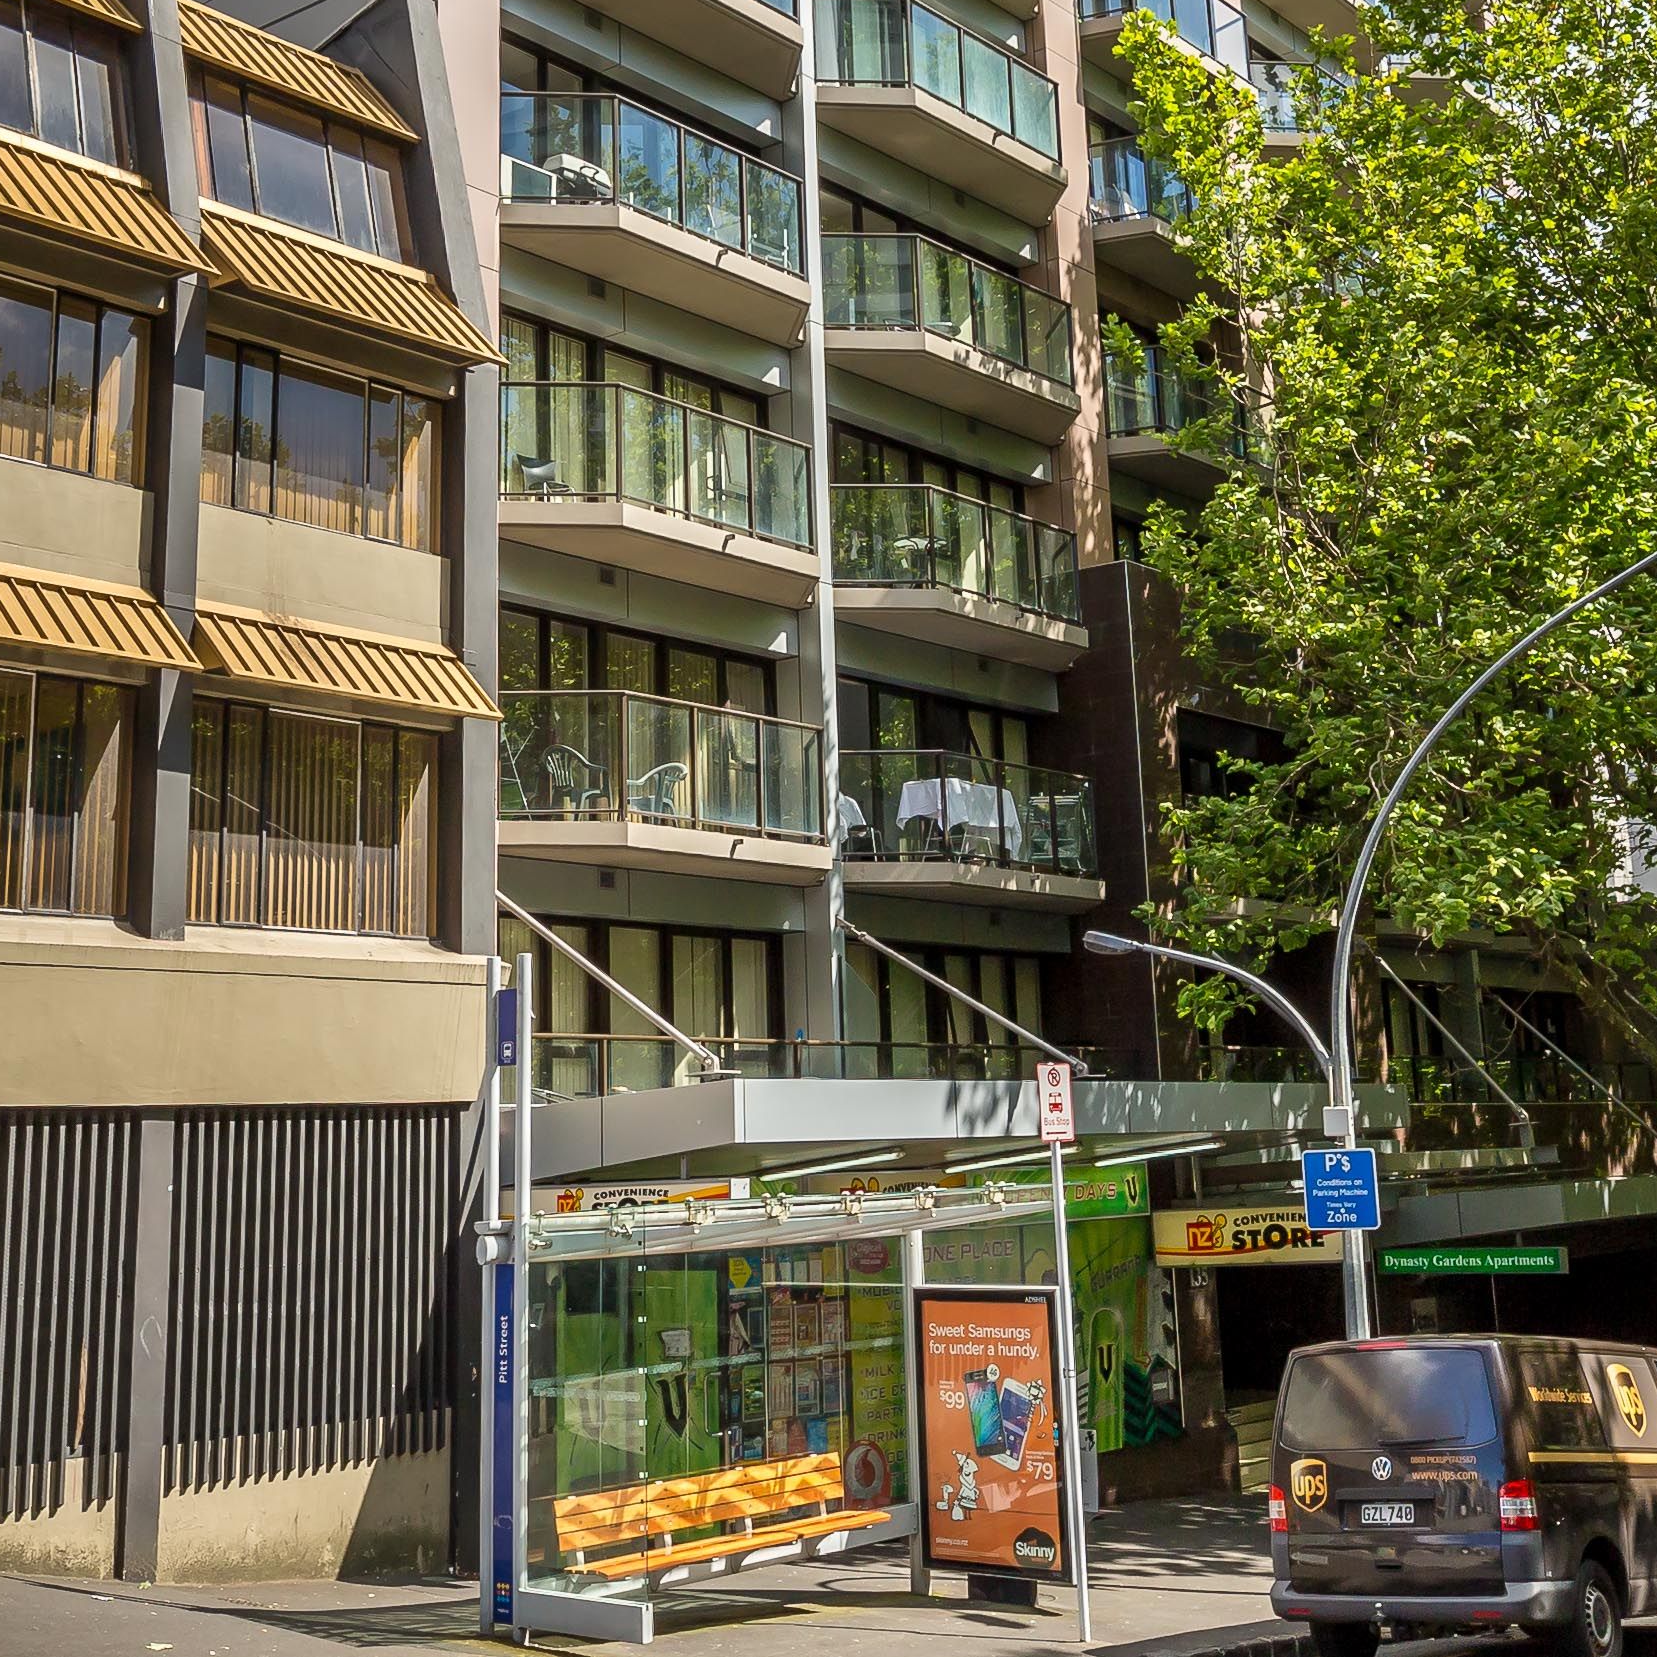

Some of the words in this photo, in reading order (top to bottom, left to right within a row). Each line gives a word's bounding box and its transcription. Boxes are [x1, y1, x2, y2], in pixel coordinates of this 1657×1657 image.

[1075, 1184, 1117, 1201] DAYS
[1317, 1179, 1352, 1187] Conditions
[594, 1188, 669, 1200] CONVENIENCE
[1313, 1189, 1339, 1198] Parking
[1340, 1189, 1368, 1197] Machine
[1327, 1210, 1357, 1223] Zone
[1231, 1223, 1325, 1250] STORE
[960, 1240, 1014, 1261] PLACE
[1384, 1255, 1429, 1269] Dynasty
[1432, 1255, 1481, 1267] Gardens
[1485, 1255, 1554, 1269] Apartments
[499, 1315, 509, 1356] Street
[928, 1323, 965, 1337] Sweet
[968, 1324, 1031, 1342] Samsungs
[929, 1340, 946, 1354] for
[949, 1340, 984, 1356] under
[987, 1346, 995, 1356] a
[998, 1342, 1040, 1360] hundy.
[499, 1359, 508, 1384] Pitt
[939, 1390, 965, 1410] $99
[1617, 1385, 1645, 1426] ups
[1026, 1460, 1054, 1481] $79
[1411, 1471, 1478, 1482] www.ups.com
[1294, 1475, 1326, 1504] ups
[1362, 1505, 1414, 1522] GZL740
[1015, 1541, 1055, 1562] Skinny
